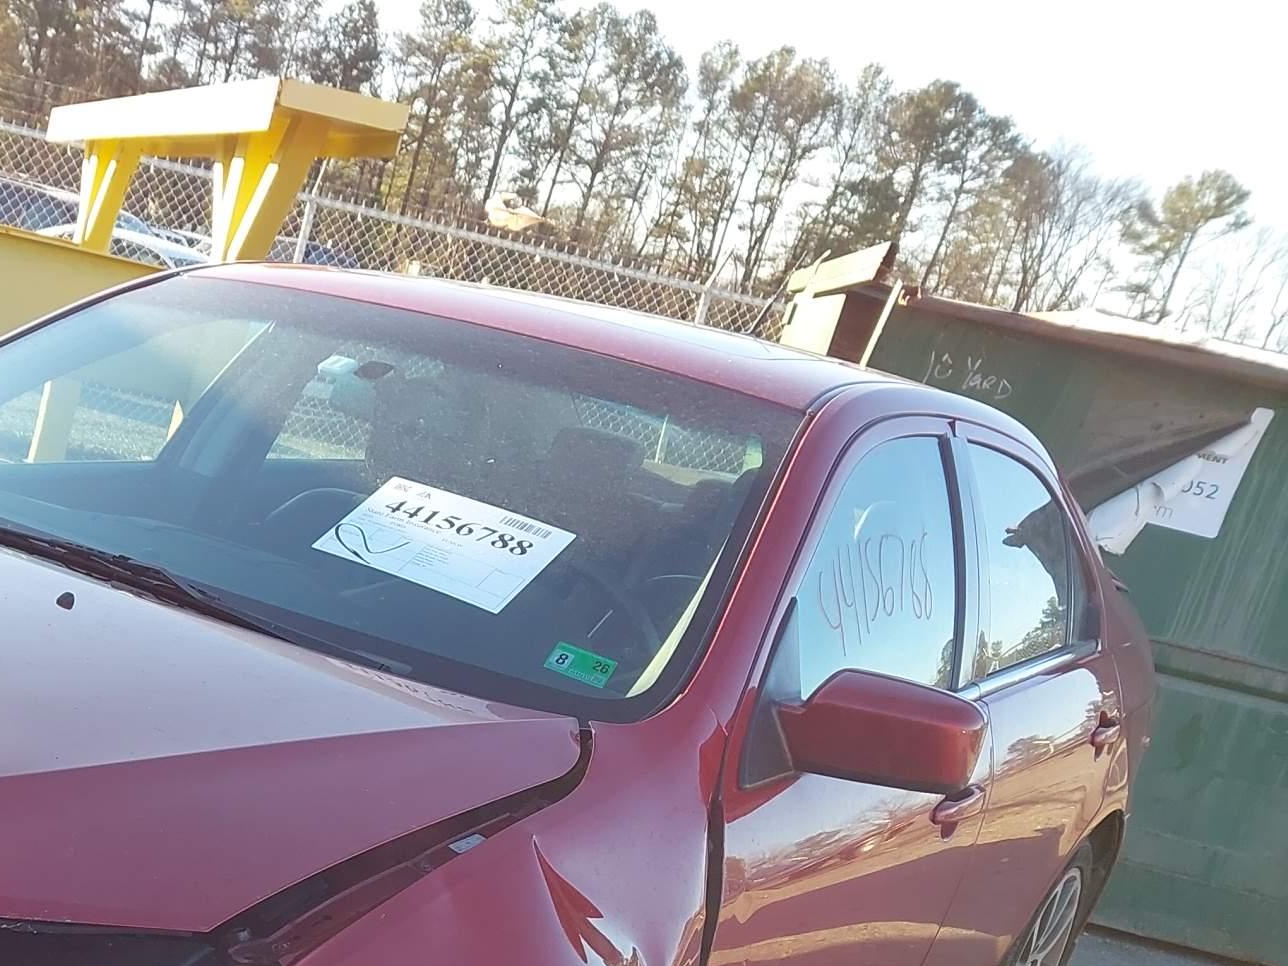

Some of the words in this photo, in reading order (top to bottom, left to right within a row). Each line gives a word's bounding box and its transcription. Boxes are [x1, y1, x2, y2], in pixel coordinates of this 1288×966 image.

[385, 500, 534, 556] 44156788
[555, 653, 569, 665] 8
[592, 661, 610, 674] 26
